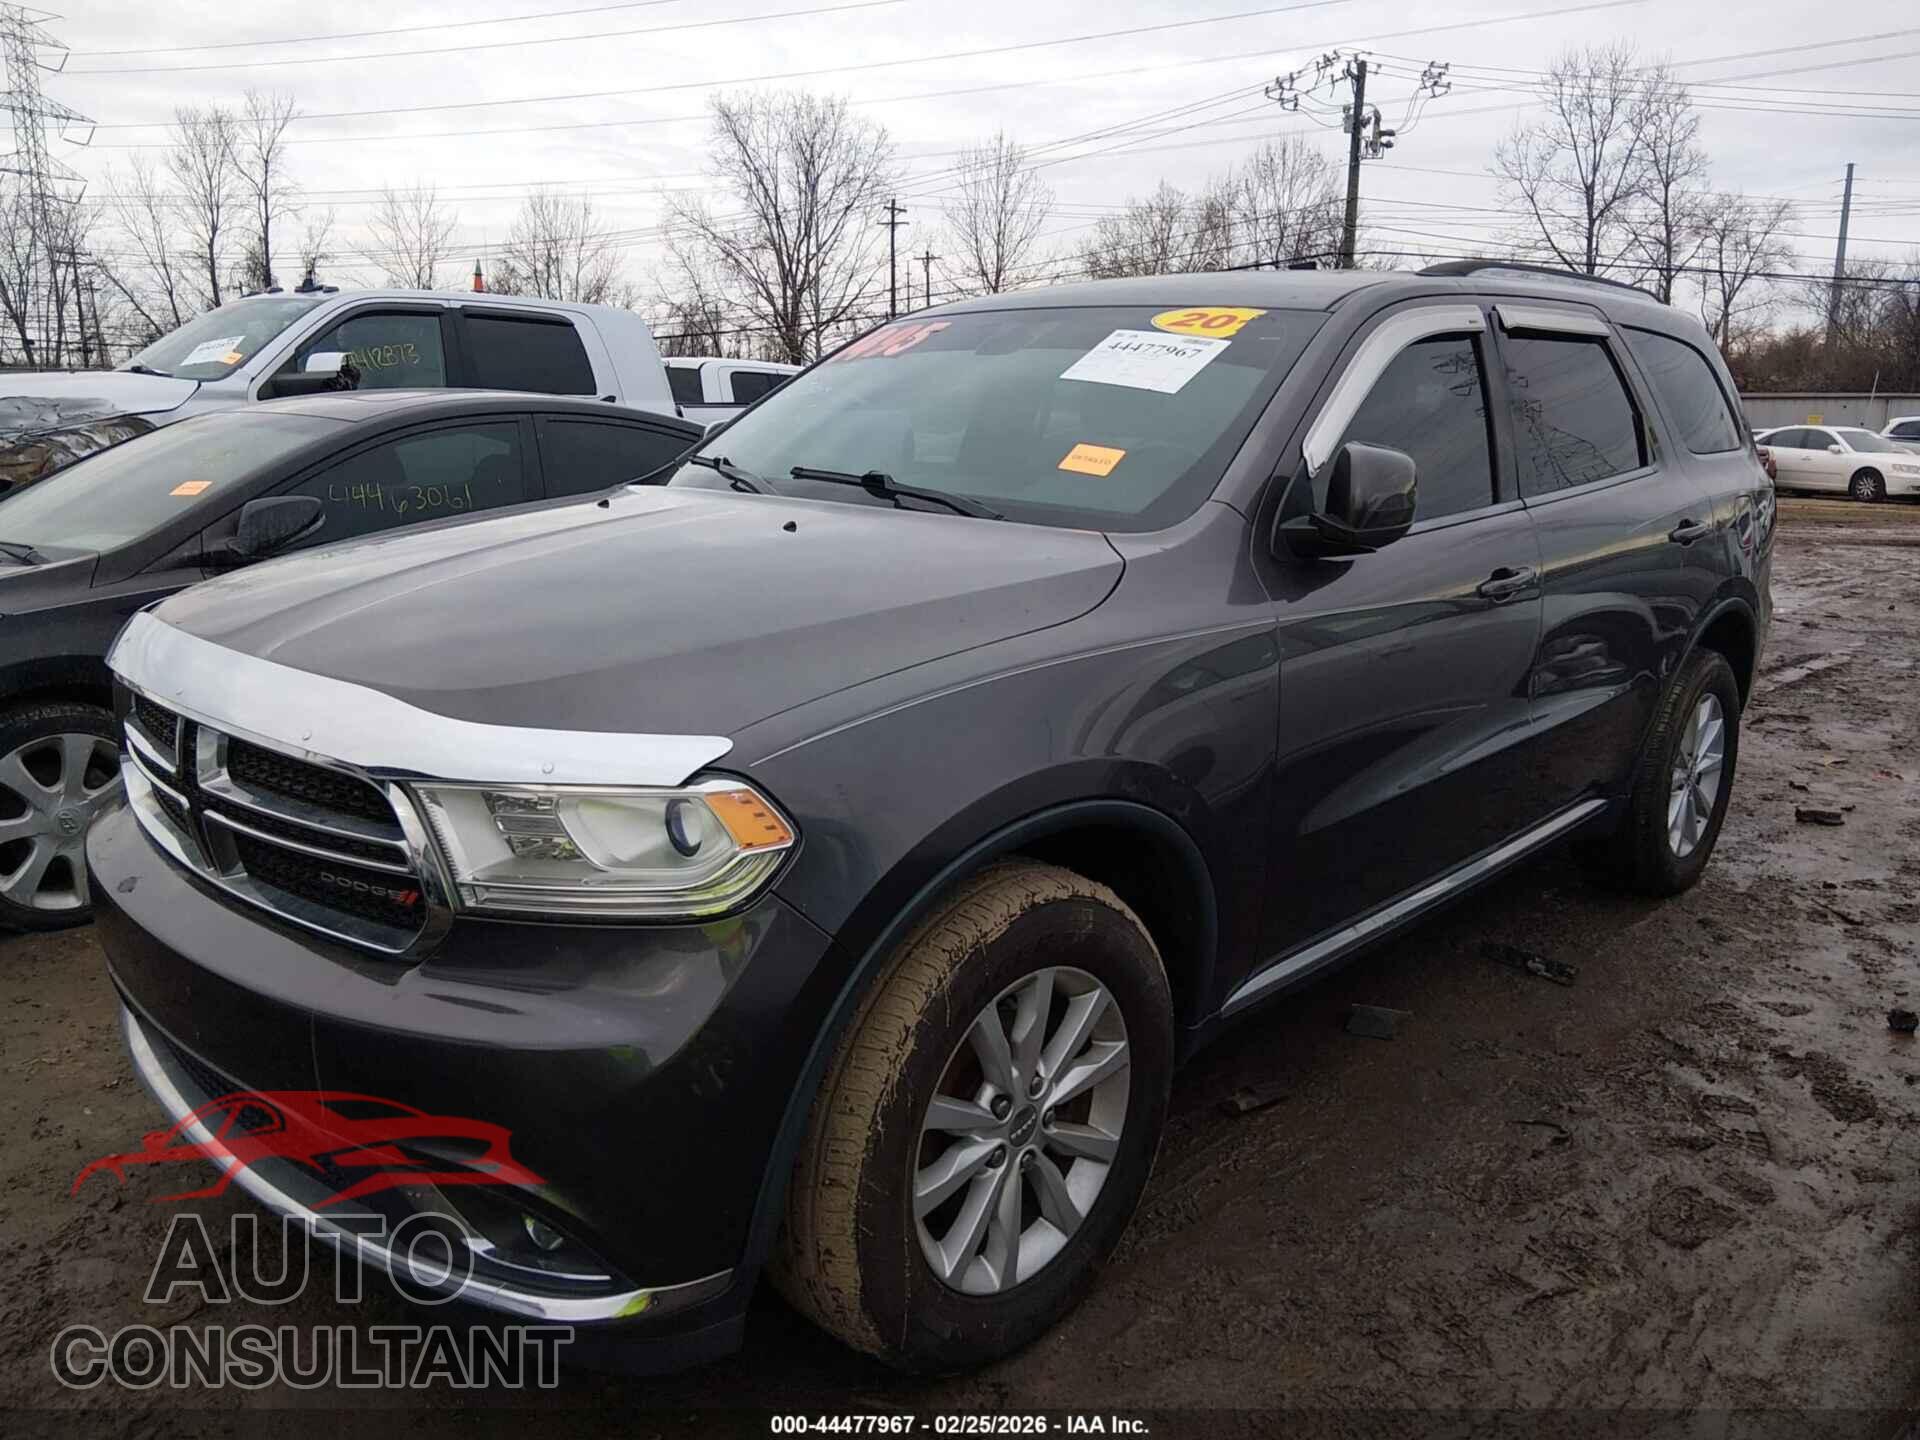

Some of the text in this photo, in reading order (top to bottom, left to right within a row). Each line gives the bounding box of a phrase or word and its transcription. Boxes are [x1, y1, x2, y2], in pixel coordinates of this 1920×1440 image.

[1166, 312, 1250, 330] 20
[1108, 341, 1202, 359] 44477967
[320, 871, 402, 901] DODGE
